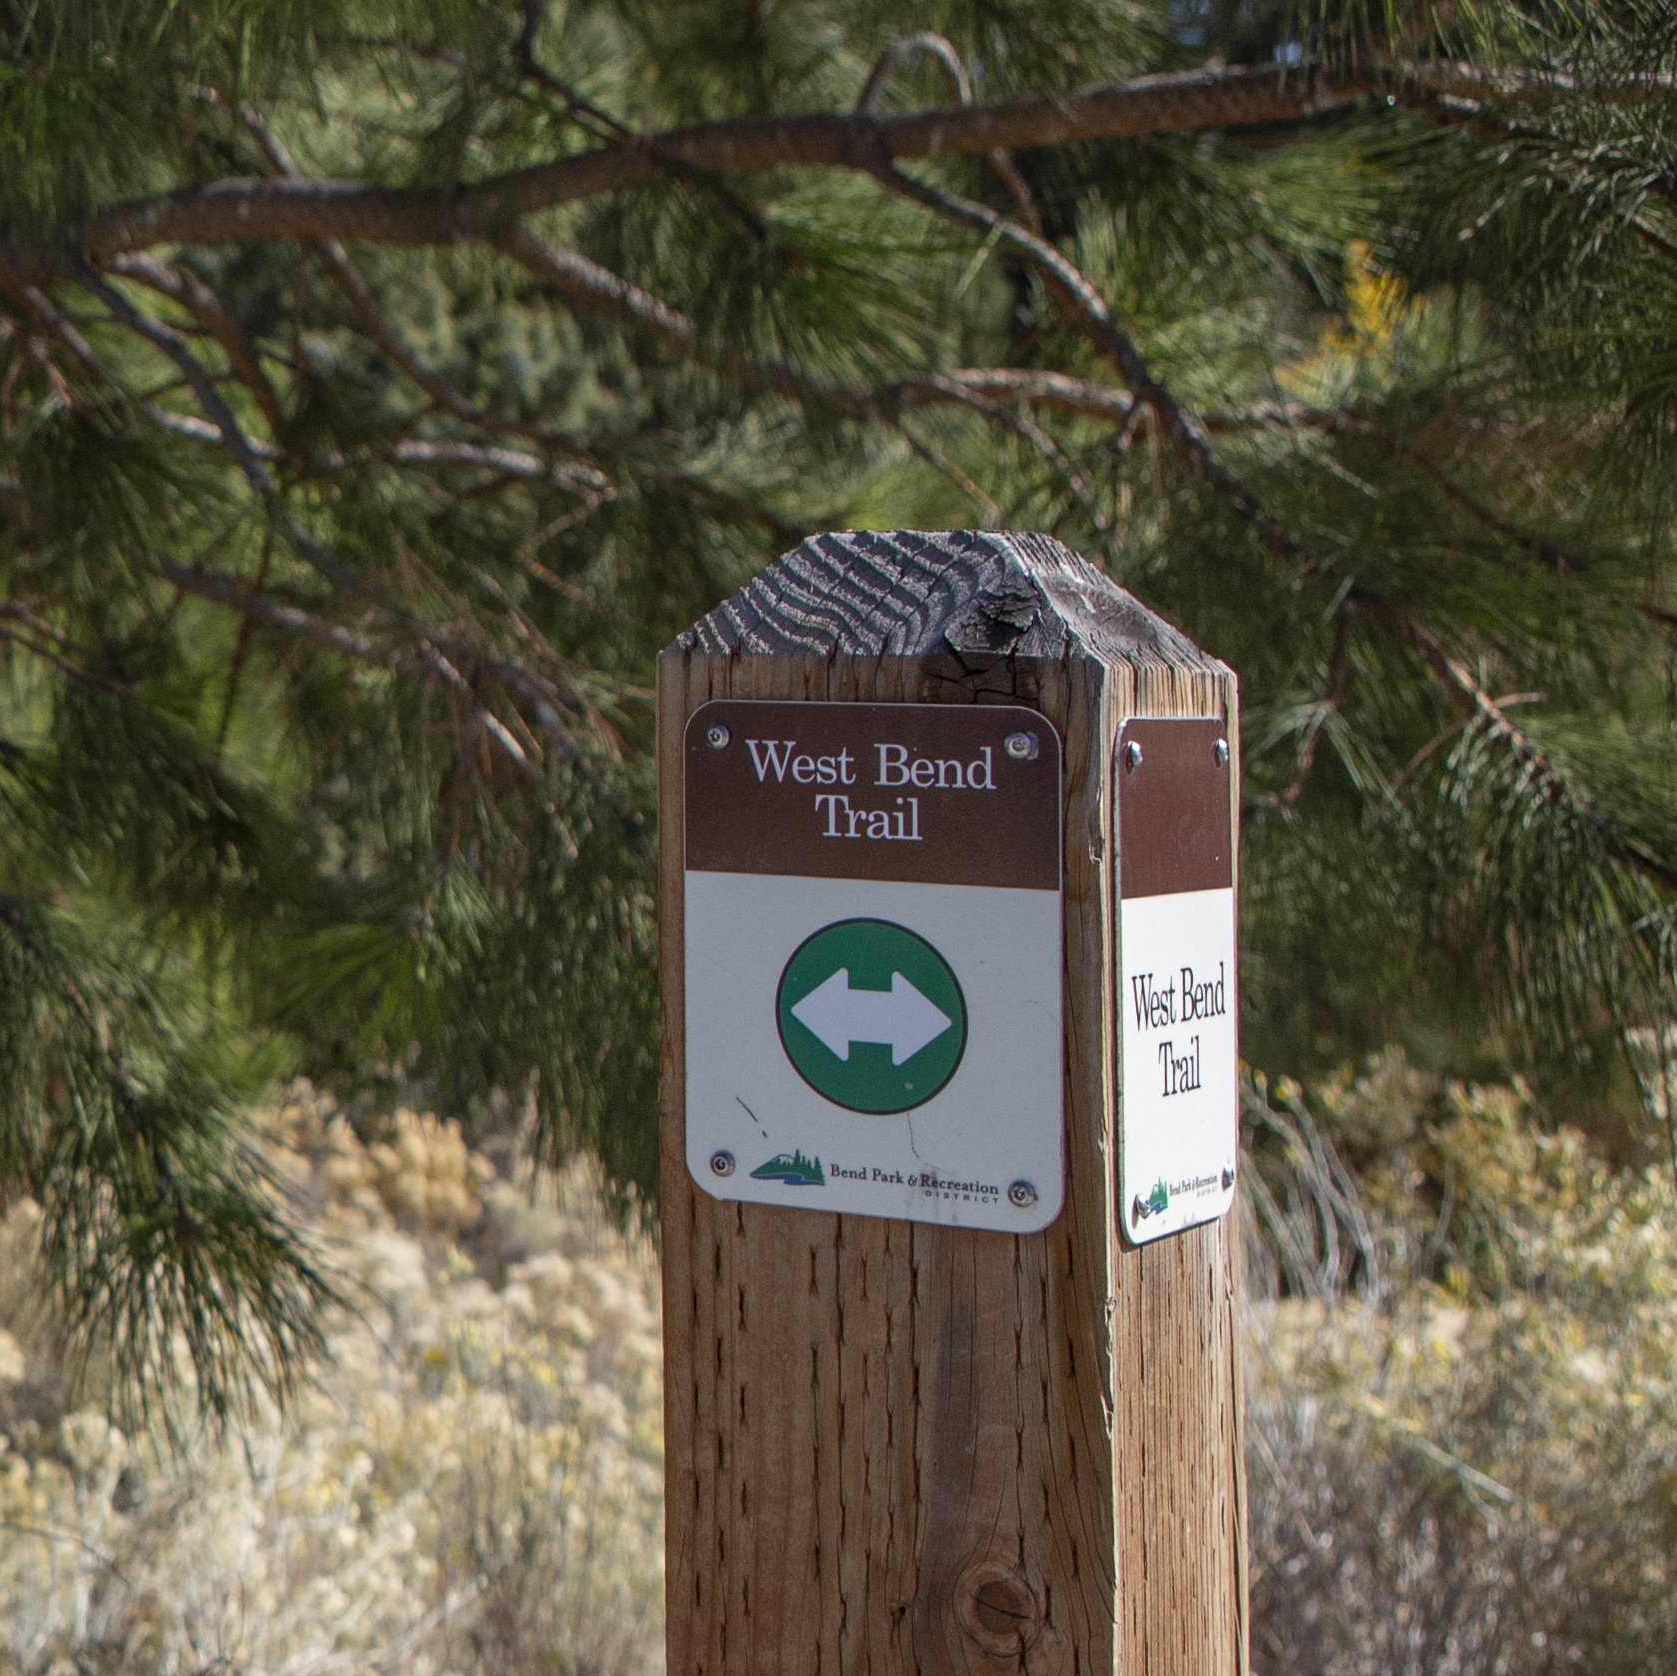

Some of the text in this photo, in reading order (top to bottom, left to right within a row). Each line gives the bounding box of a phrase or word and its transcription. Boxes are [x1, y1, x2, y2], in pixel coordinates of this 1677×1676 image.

[745, 739, 996, 790] West Bend
[814, 794, 922, 841] Trail
[1132, 961, 1226, 1032] West Bend
[1158, 1035, 1202, 1098] Trail
[830, 1163, 999, 1195] Bend Park & Recreation
[925, 1189, 1000, 1204] DISTRICT
